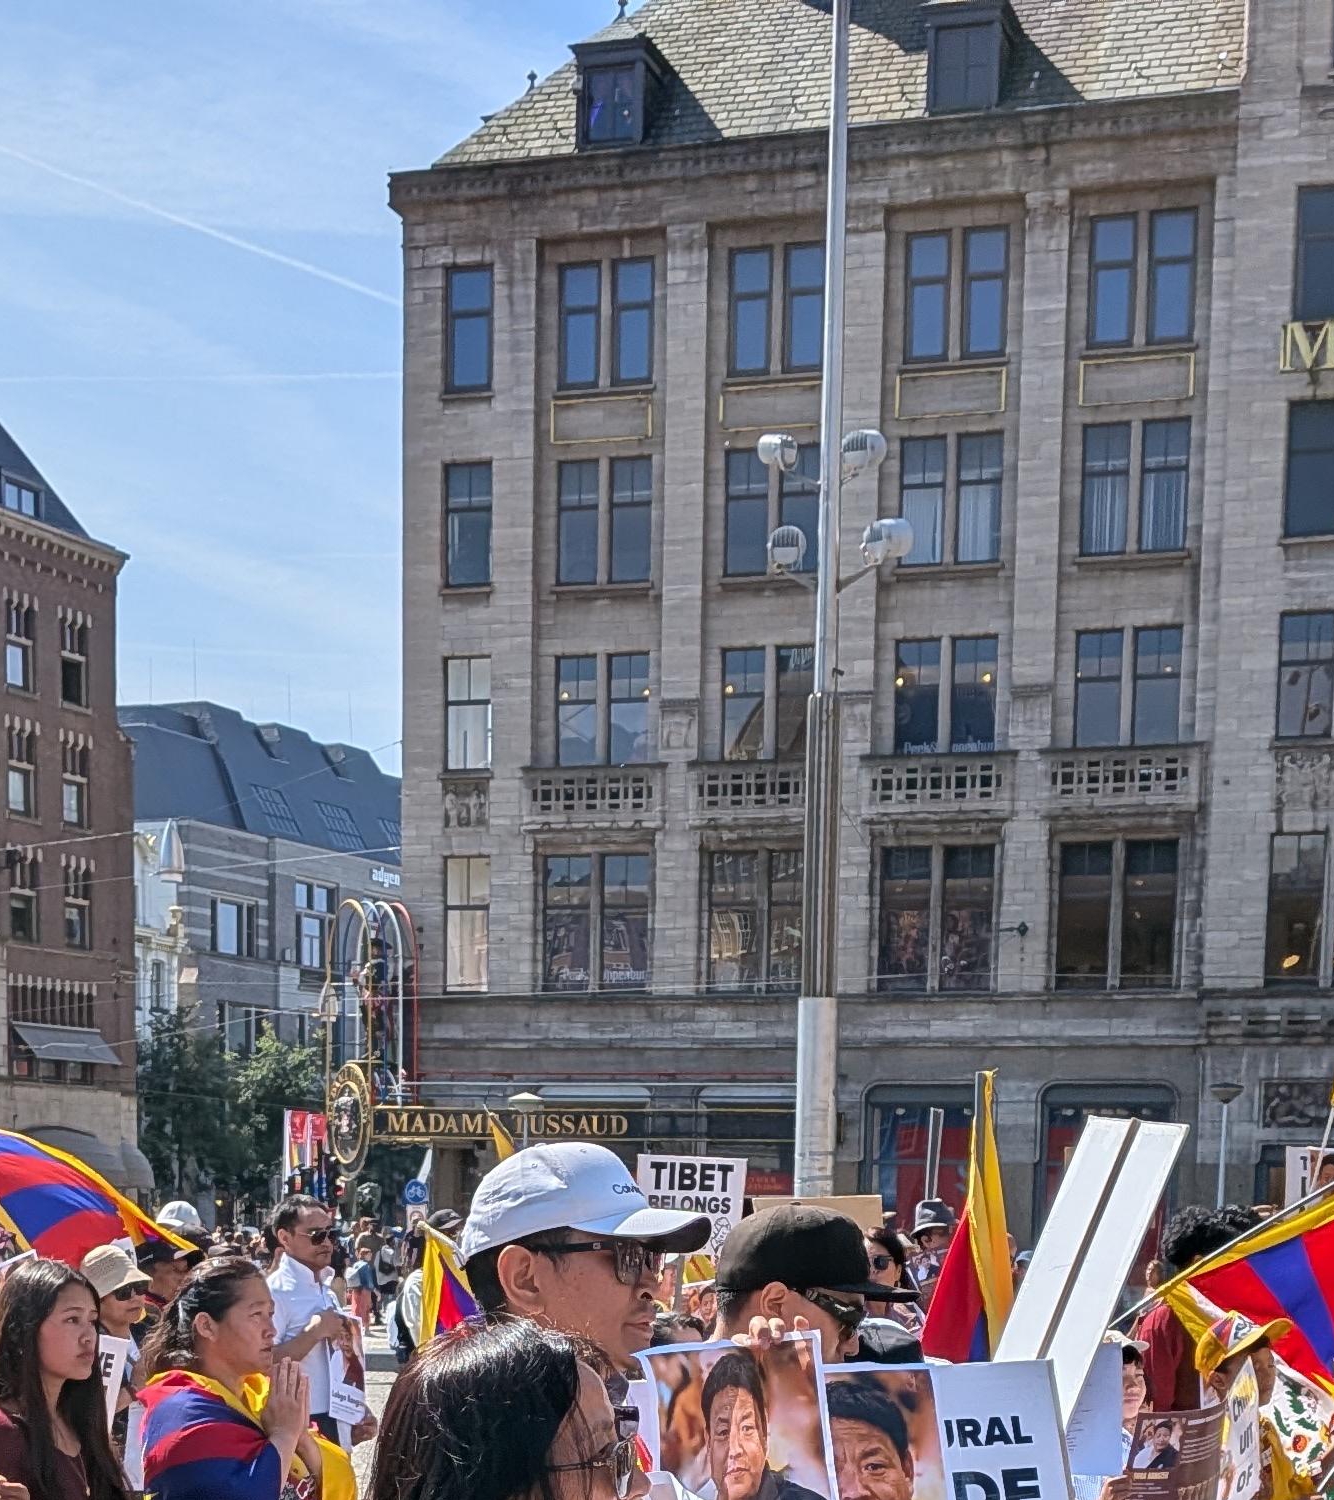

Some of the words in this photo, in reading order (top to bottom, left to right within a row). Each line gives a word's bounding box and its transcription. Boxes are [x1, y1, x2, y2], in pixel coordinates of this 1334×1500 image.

[514, 1113, 629, 1136] TUSSAUD
[650, 1161, 734, 1193] TIBET
[648, 1195, 731, 1214] BELONGS
[1239, 1421, 1254, 1455] UIT
[1236, 1462, 1254, 1493] OF
